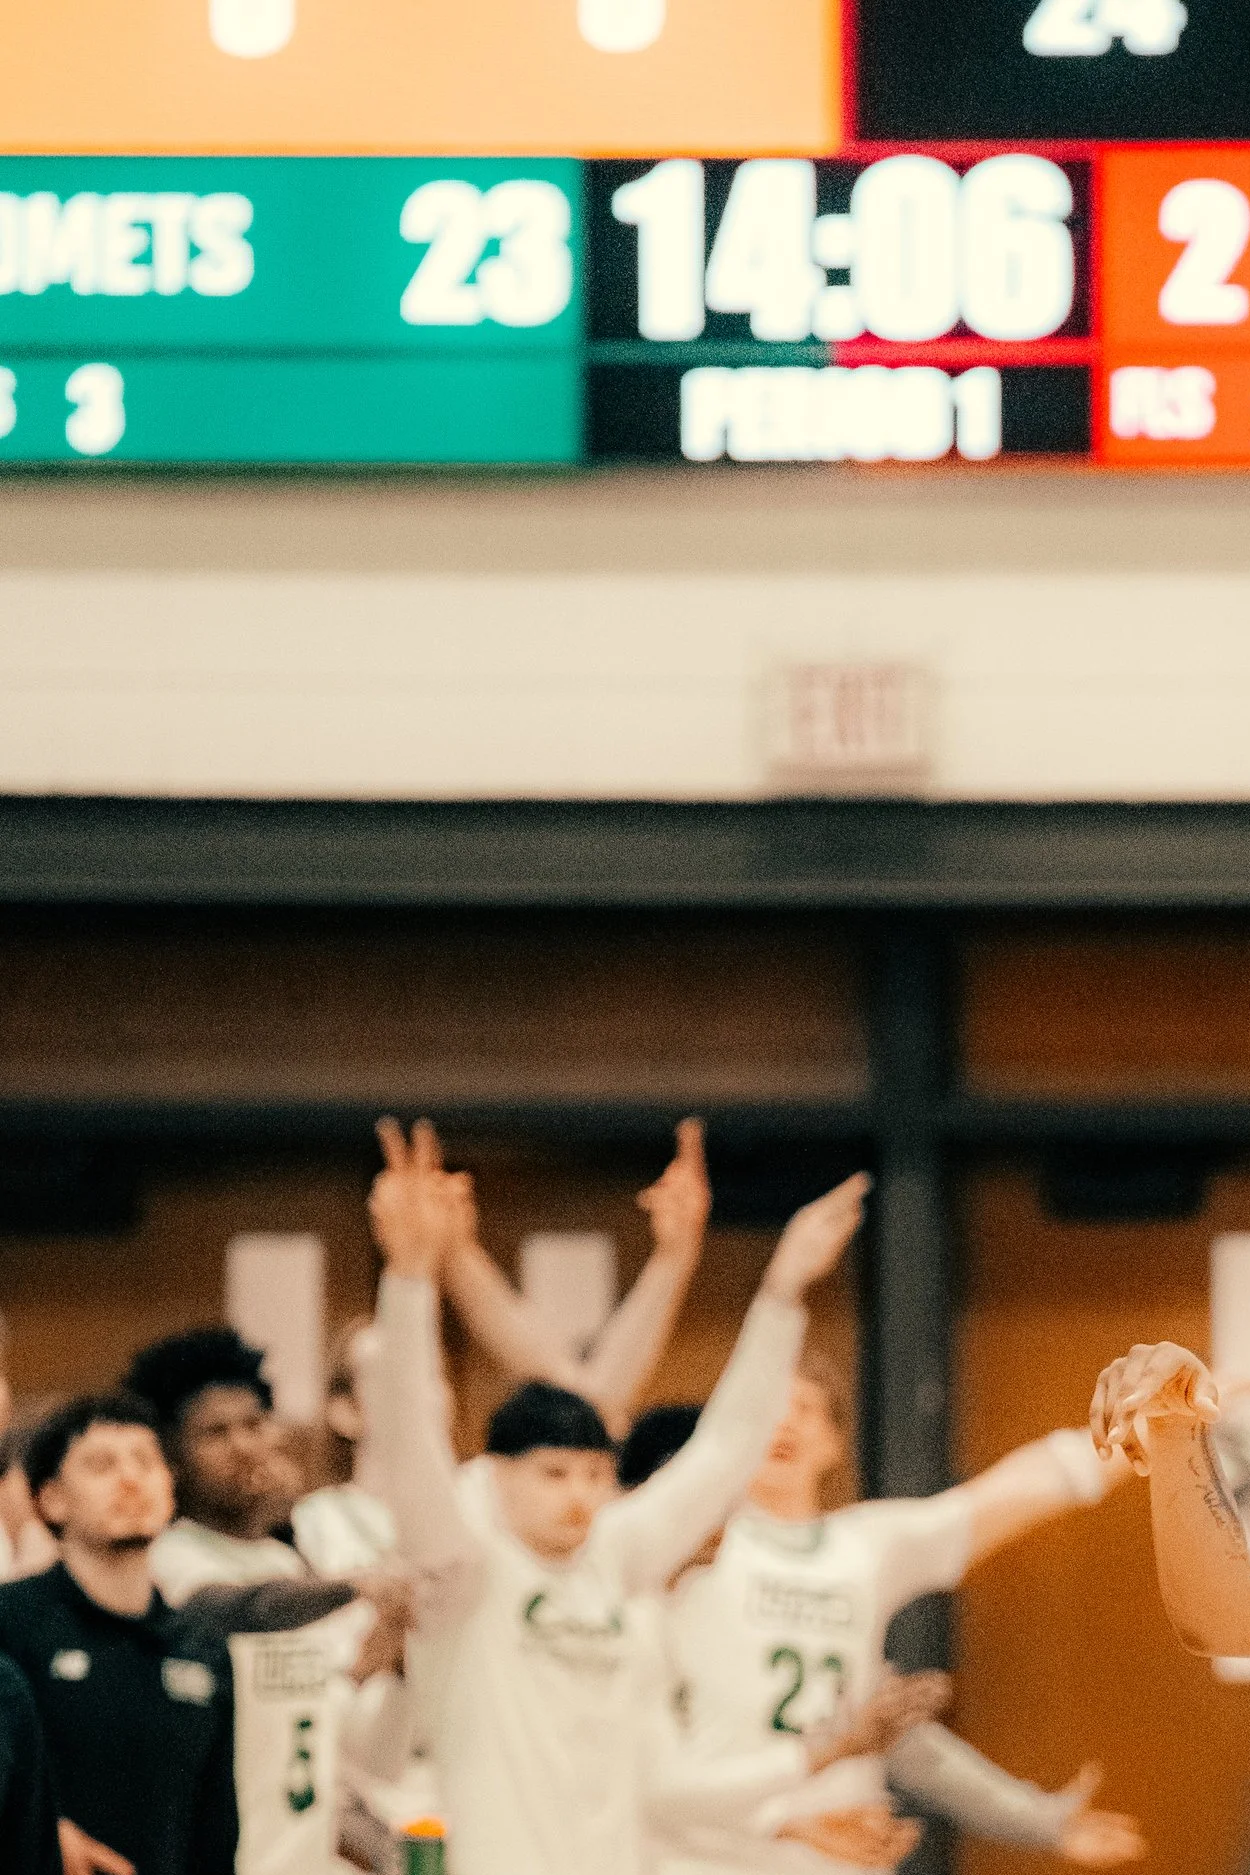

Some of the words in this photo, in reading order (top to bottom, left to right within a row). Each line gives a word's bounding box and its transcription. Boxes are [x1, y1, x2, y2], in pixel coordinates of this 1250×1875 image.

[400, 180, 572, 326] 23
[612, 154, 1074, 341] 14:06
[65, 363, 125, 455] 3
